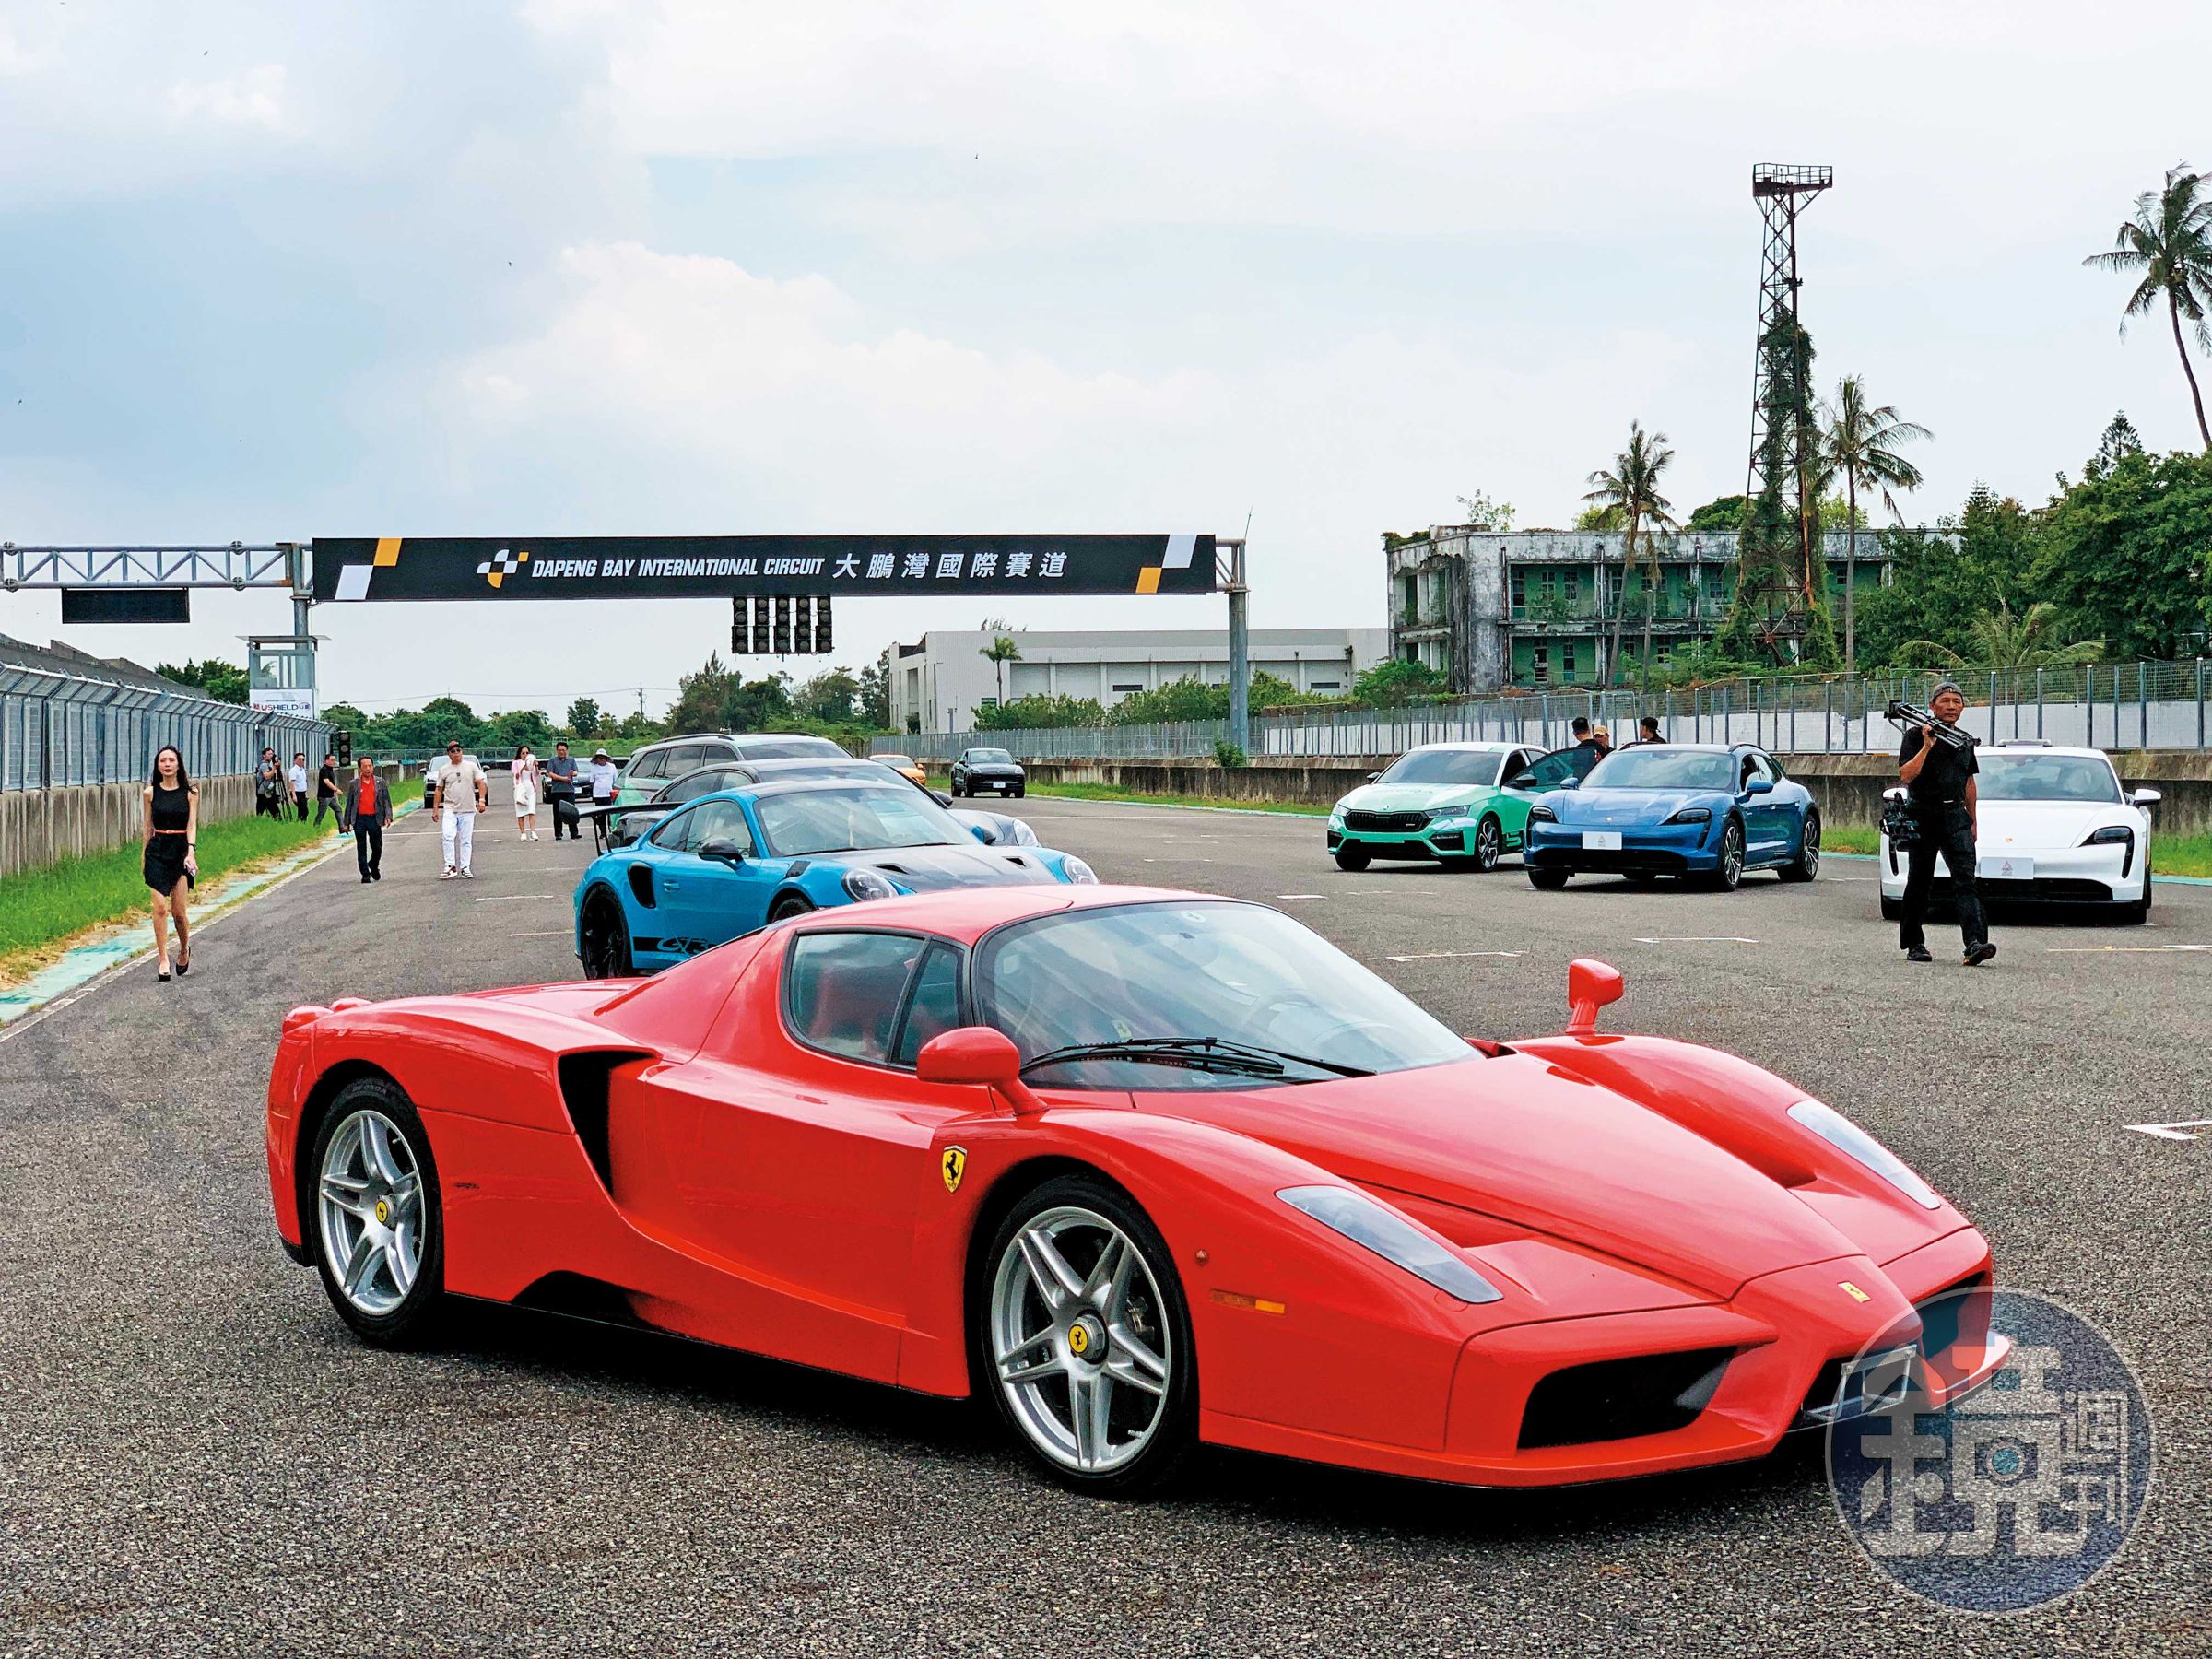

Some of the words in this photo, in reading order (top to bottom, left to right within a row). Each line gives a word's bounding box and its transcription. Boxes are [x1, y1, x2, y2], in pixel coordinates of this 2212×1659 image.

[532, 559, 598, 578] DAPENG
[601, 559, 636, 577] BAY
[637, 558, 759, 577] INTERNATIONAL
[763, 558, 826, 575] CIRCUIT
[831, 552, 1067, 580] 大鵬灣國際賽道
[261, 703, 299, 712] USHIELD
